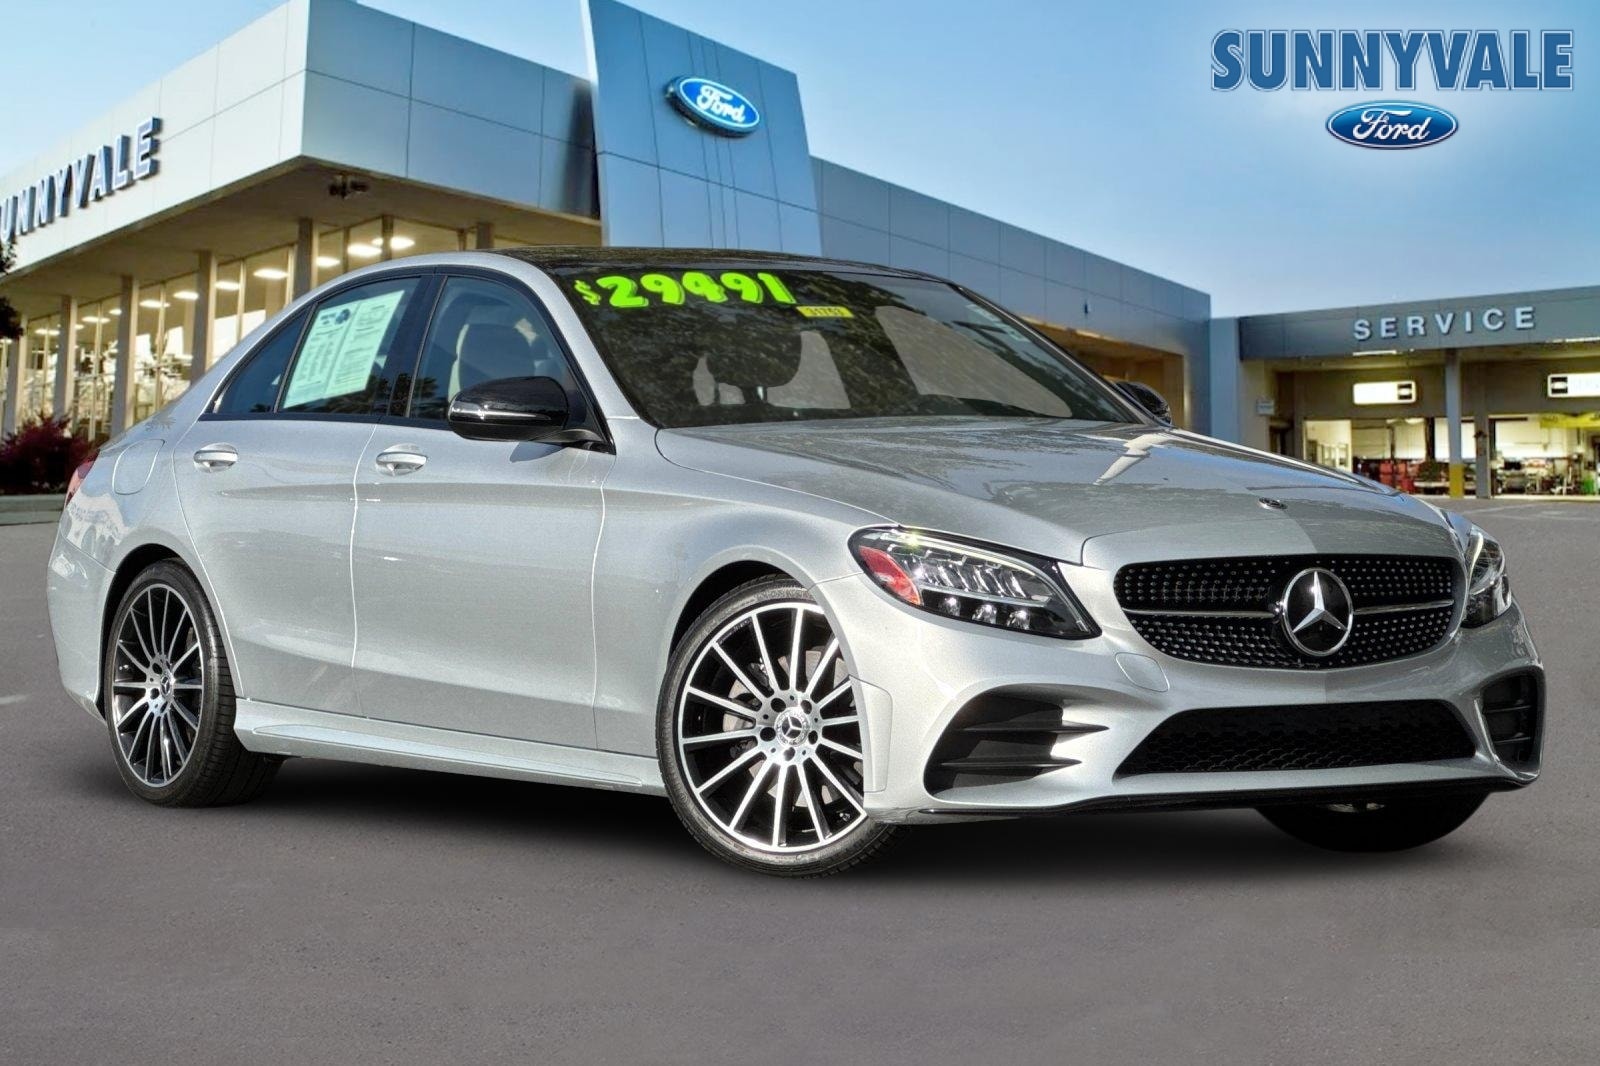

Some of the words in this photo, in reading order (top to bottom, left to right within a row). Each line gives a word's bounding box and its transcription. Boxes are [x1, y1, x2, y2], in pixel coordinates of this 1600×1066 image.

[695, 84, 746, 122] Ford
[0, 116, 162, 243] UNNYVALE
[573, 272, 797, 308] $29491
[1353, 305, 1535, 341] SERVICE
